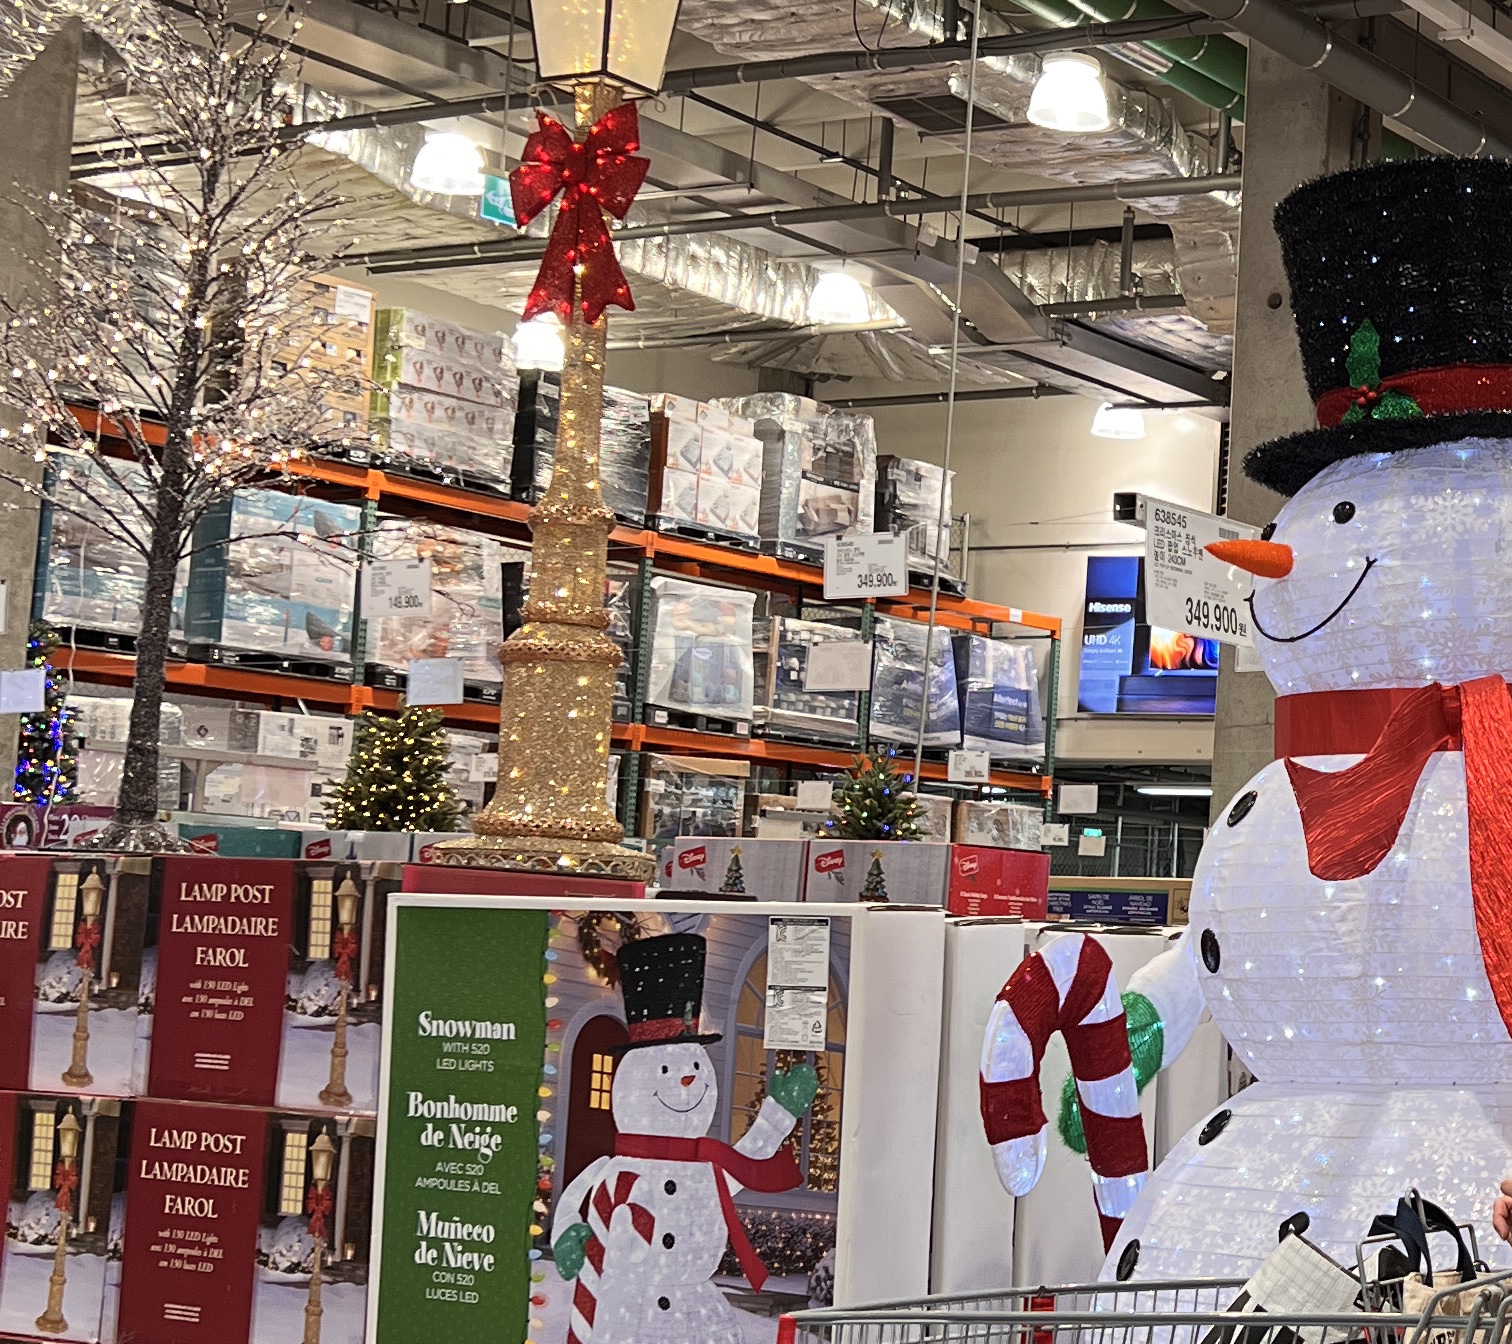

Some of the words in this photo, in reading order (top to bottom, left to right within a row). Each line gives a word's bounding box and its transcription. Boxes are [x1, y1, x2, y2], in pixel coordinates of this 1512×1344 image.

[1154, 508, 1188, 529] 638545
[1088, 602, 1132, 613] Hisense
[1084, 634, 1107, 646] UHD
[1108, 635, 1121, 646] 4K
[180, 882, 228, 902] LAMP
[229, 884, 274, 904] POST
[171, 914, 279, 936] LAMPADAIRE
[195, 947, 249, 968] FAROL
[418, 1010, 516, 1041] Snowman
[442, 1041, 470, 1054] WITH
[471, 1044, 490, 1055] 520
[436, 1058, 457, 1070] LED
[458, 1060, 495, 1072] LIGHTS
[406, 1091, 518, 1124] Bonhomme
[149, 1128, 197, 1150] LAMP
[200, 1131, 246, 1154] POST
[420, 1123, 445, 1148] de
[448, 1123, 502, 1164] Neige
[140, 1159, 249, 1188] LAMPADAIRE
[435, 1161, 464, 1175] AVEC
[465, 1164, 485, 1176] 520
[415, 1177, 471, 1193] AMPOULES
[482, 1182, 502, 1195] DEL
[164, 1195, 218, 1218] FAROL
[416, 1210, 496, 1244] Muñeco
[414, 1241, 438, 1267] de
[441, 1242, 495, 1272] Nieve
[432, 1271, 456, 1284] CON
[456, 1274, 475, 1286] 520
[425, 1287, 458, 1302] LUCES
[459, 1290, 480, 1304] LED
